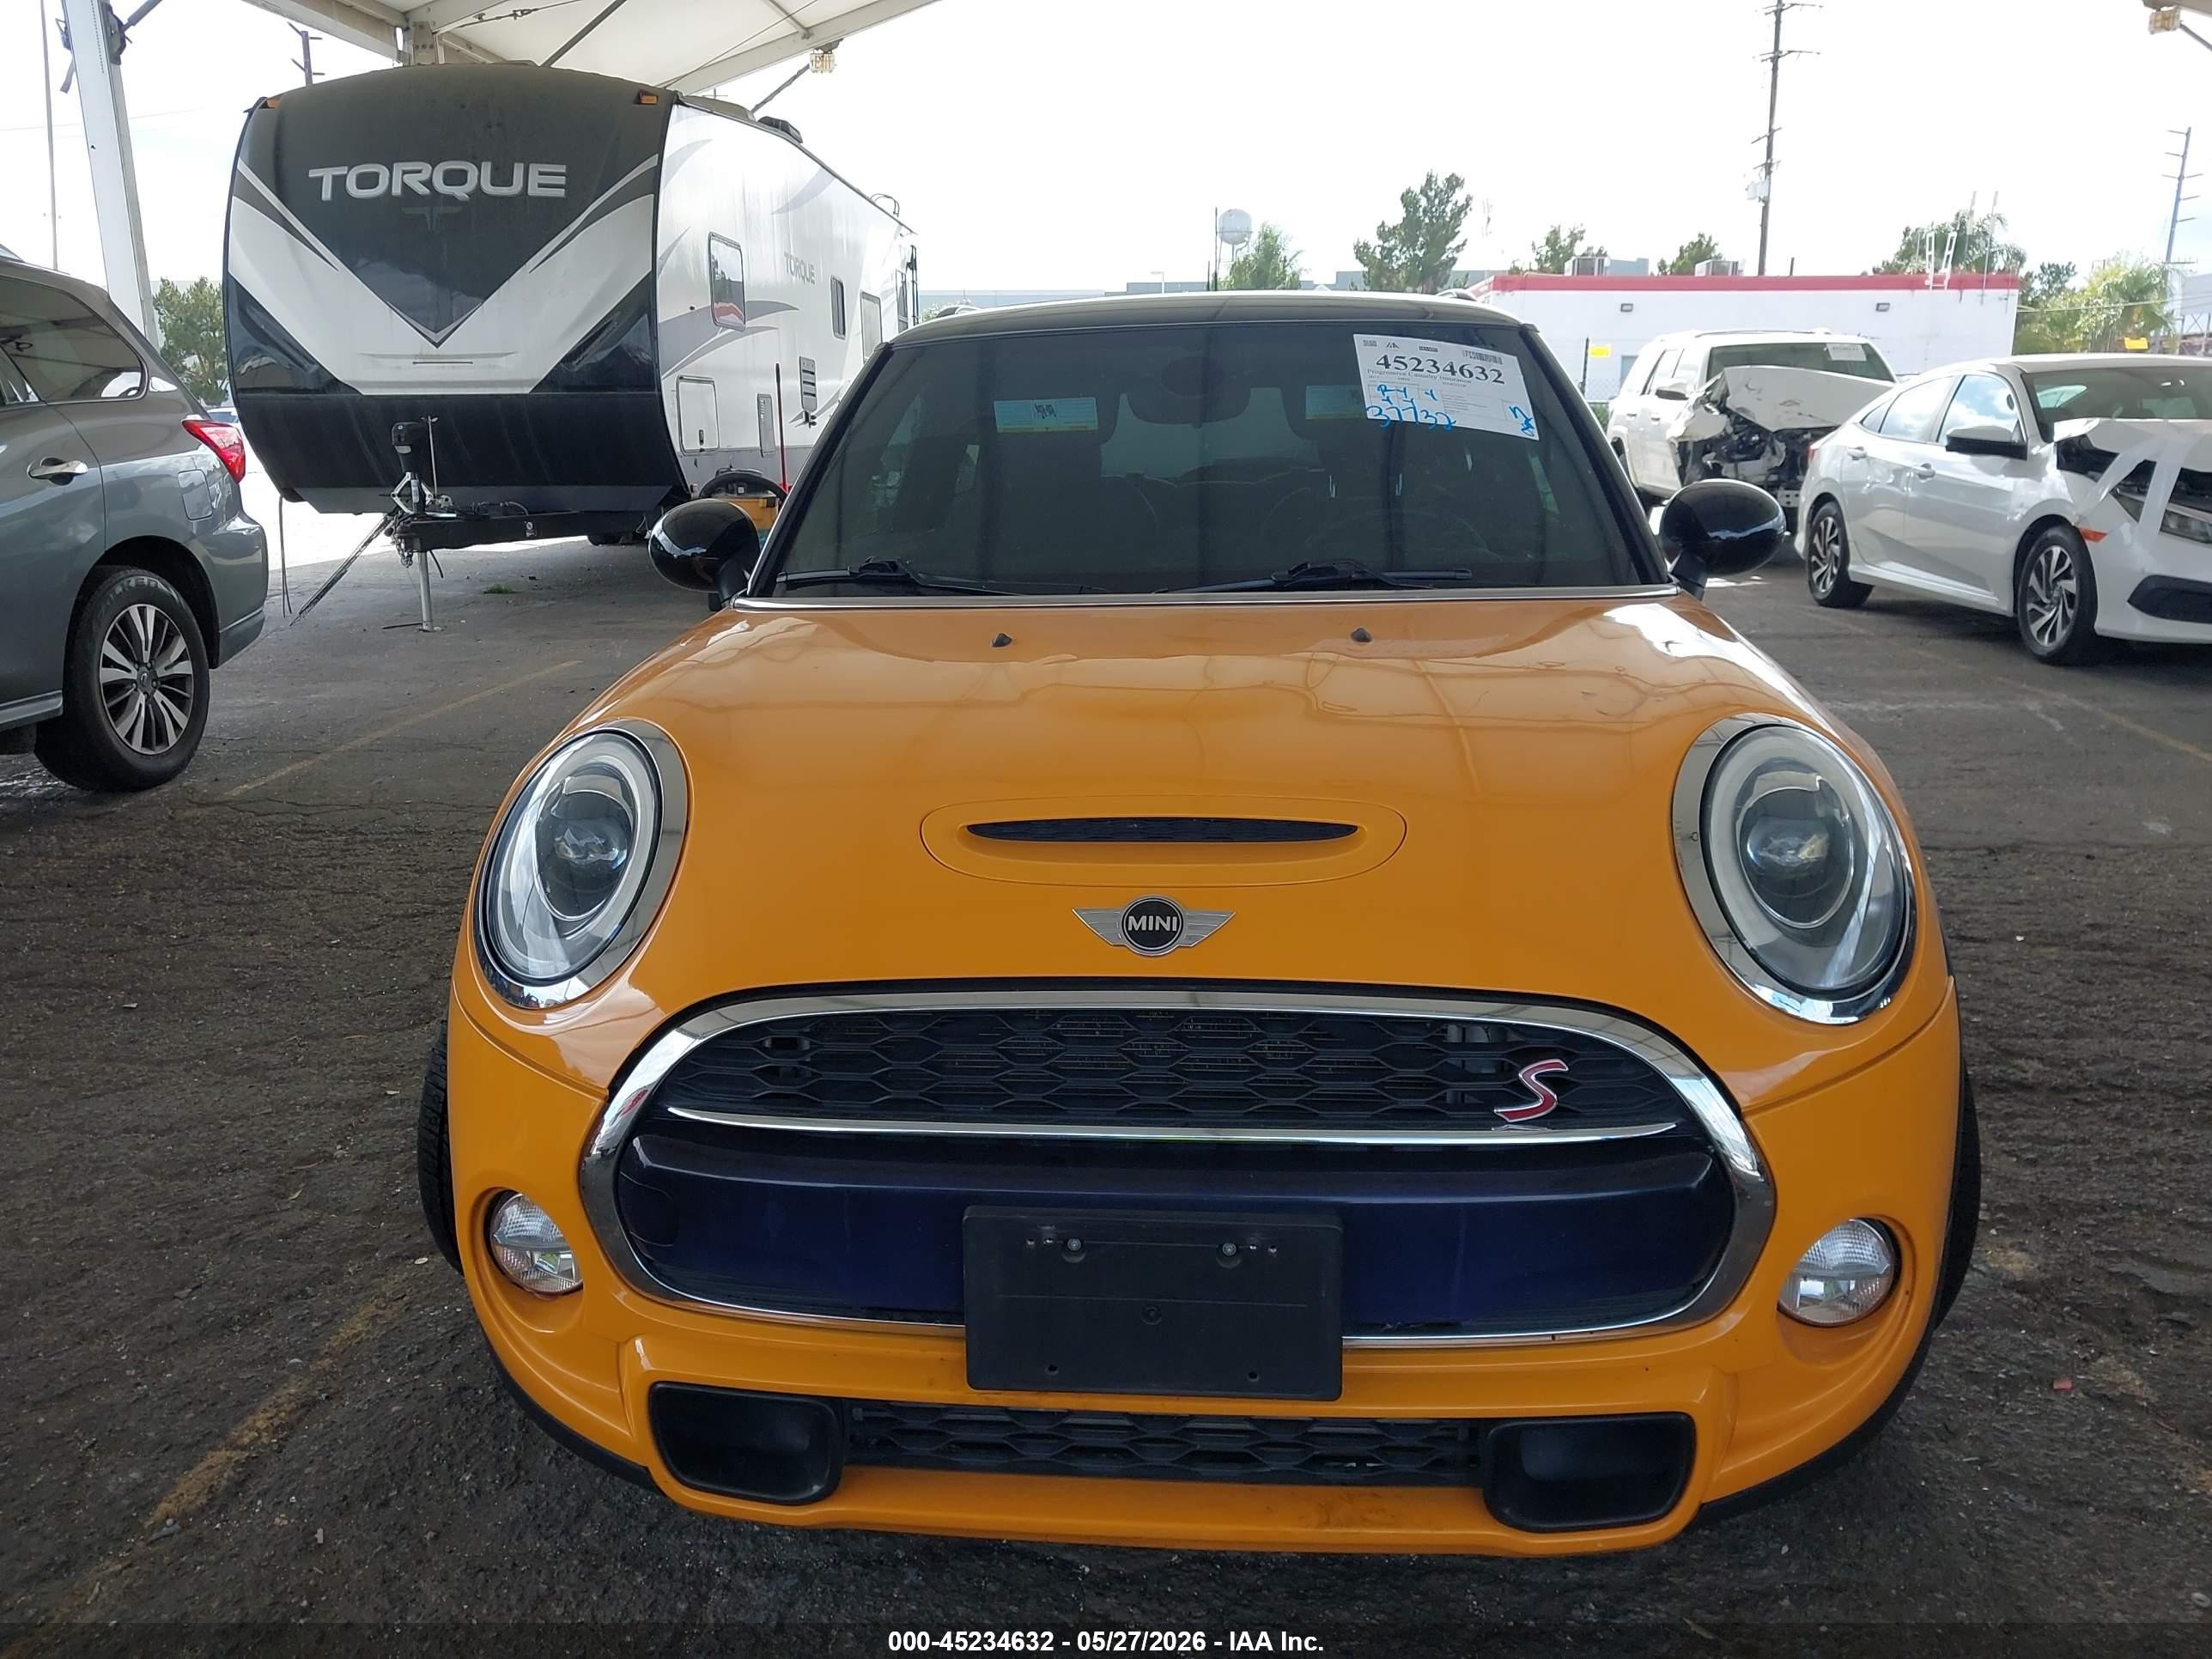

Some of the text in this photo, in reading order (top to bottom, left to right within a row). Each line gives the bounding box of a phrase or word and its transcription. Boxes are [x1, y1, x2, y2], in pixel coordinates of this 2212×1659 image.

[308, 160, 567, 202] TORQUE
[784, 251, 815, 285] TORQUE
[1367, 368, 1407, 377] Progressive
[1376, 354, 1505, 385] 45234632
[1127, 915, 1177, 932] MINI
[1494, 1058, 1569, 1123] S
